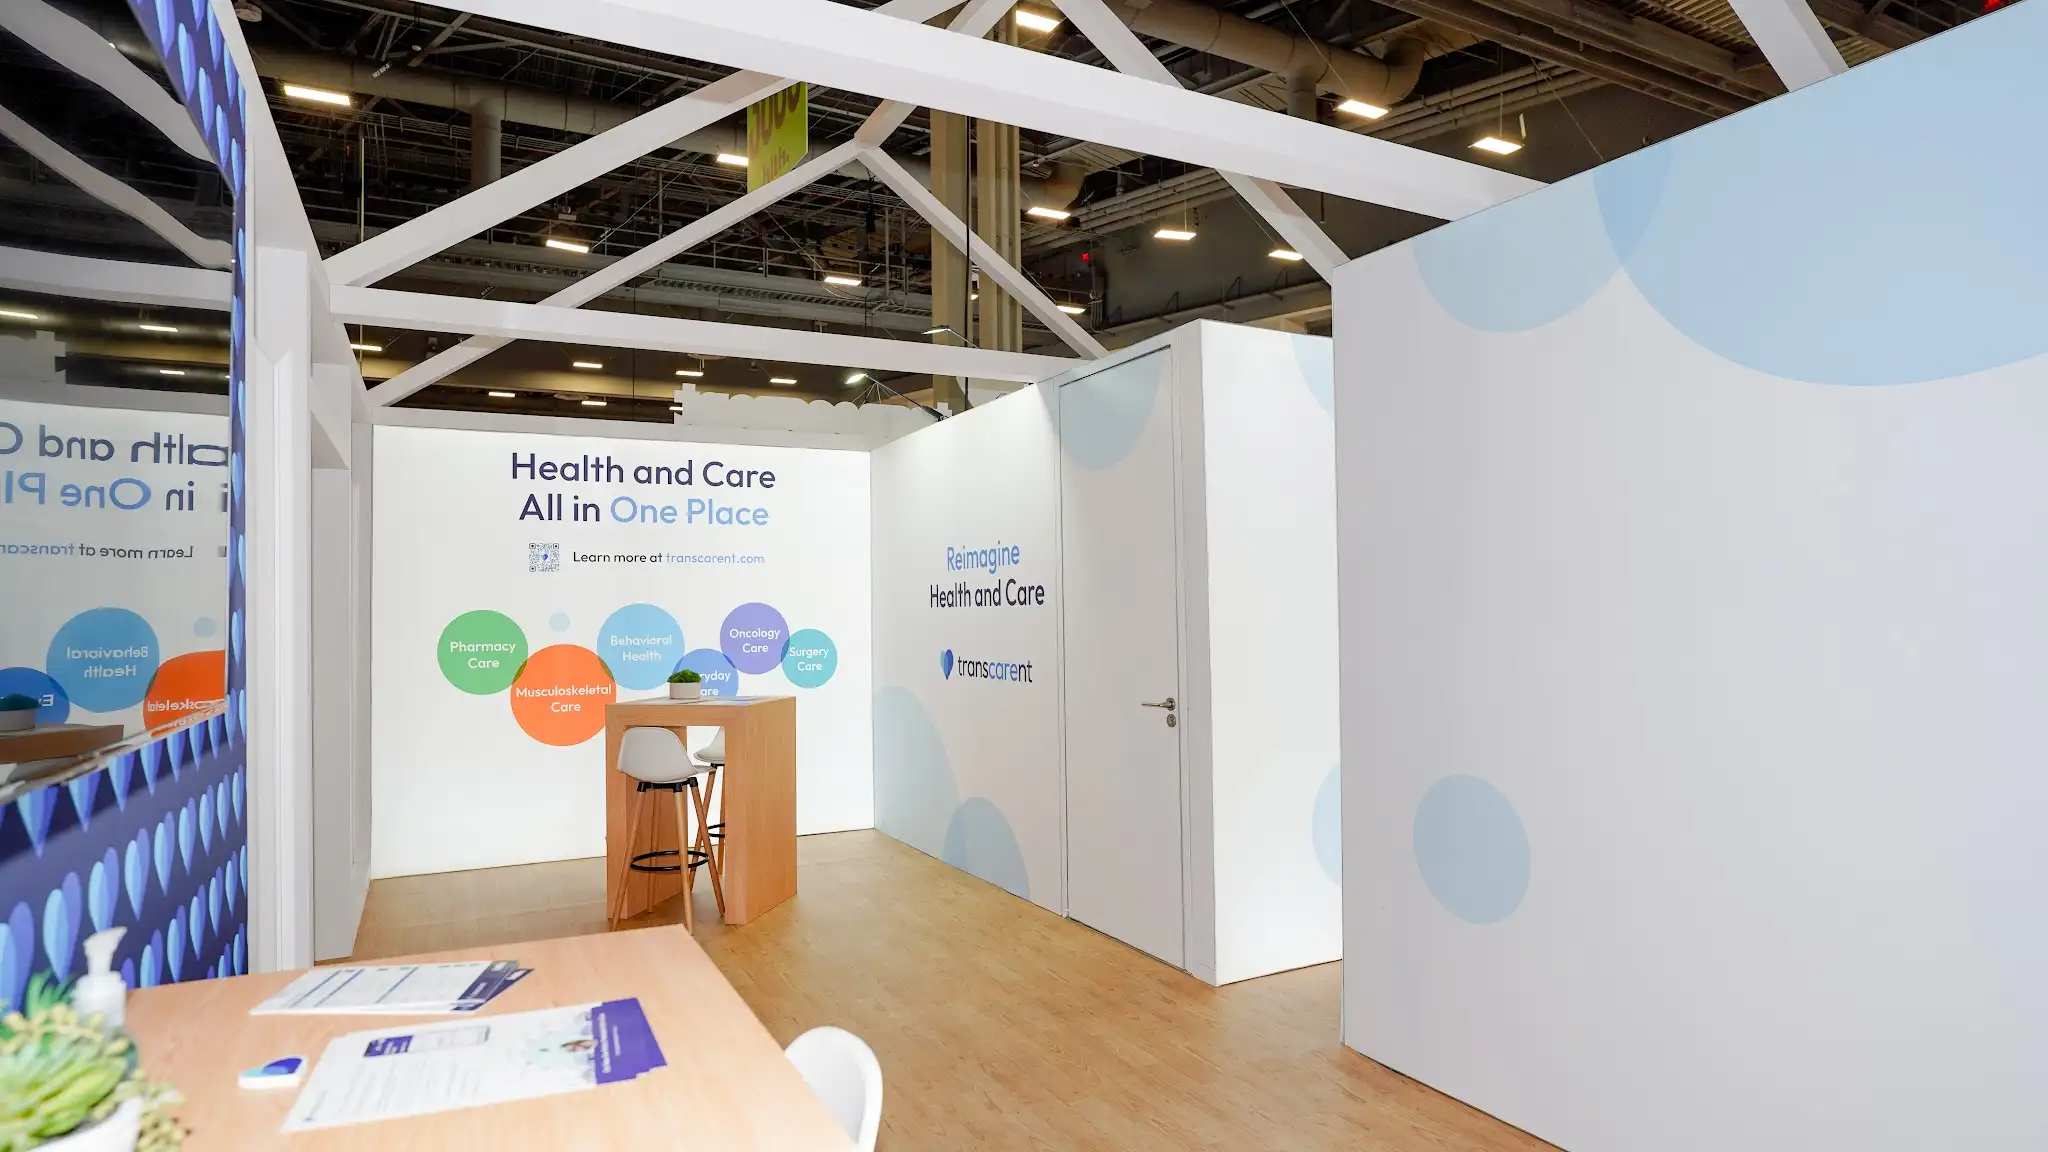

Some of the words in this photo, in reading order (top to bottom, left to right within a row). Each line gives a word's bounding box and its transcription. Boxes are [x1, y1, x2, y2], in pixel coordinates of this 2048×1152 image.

[512, 452, 624, 483] Health
[633, 459, 693, 486] and
[702, 461, 776, 489] Care
[518, 493, 562, 521] All
[573, 494, 601, 522] in
[610, 495, 678, 524] One
[686, 498, 769, 526] Place
[573, 551, 611, 564] Learn
[614, 554, 647, 564] more
[649, 552, 663, 564] at
[665, 552, 765, 565] transcarent.com
[947, 540, 1020, 572] Reimagine
[930, 583, 971, 607] Health
[974, 578, 1002, 607] and
[1005, 578, 1045, 607] Care
[609, 634, 672, 648] Behavioral
[729, 627, 781, 641] Oncology
[449, 640, 517, 655] Pharmacy
[742, 643, 769, 654] Care
[788, 645, 829, 660] Surgery
[621, 650, 662, 662] Health
[467, 657, 500, 670] Care
[796, 662, 823, 673] Care
[958, 657, 1032, 682] transcarent
[698, 668, 731, 684] ryday
[515, 682, 613, 699] Musculoskeletal
[699, 688, 720, 698] are
[550, 701, 582, 714] Care
